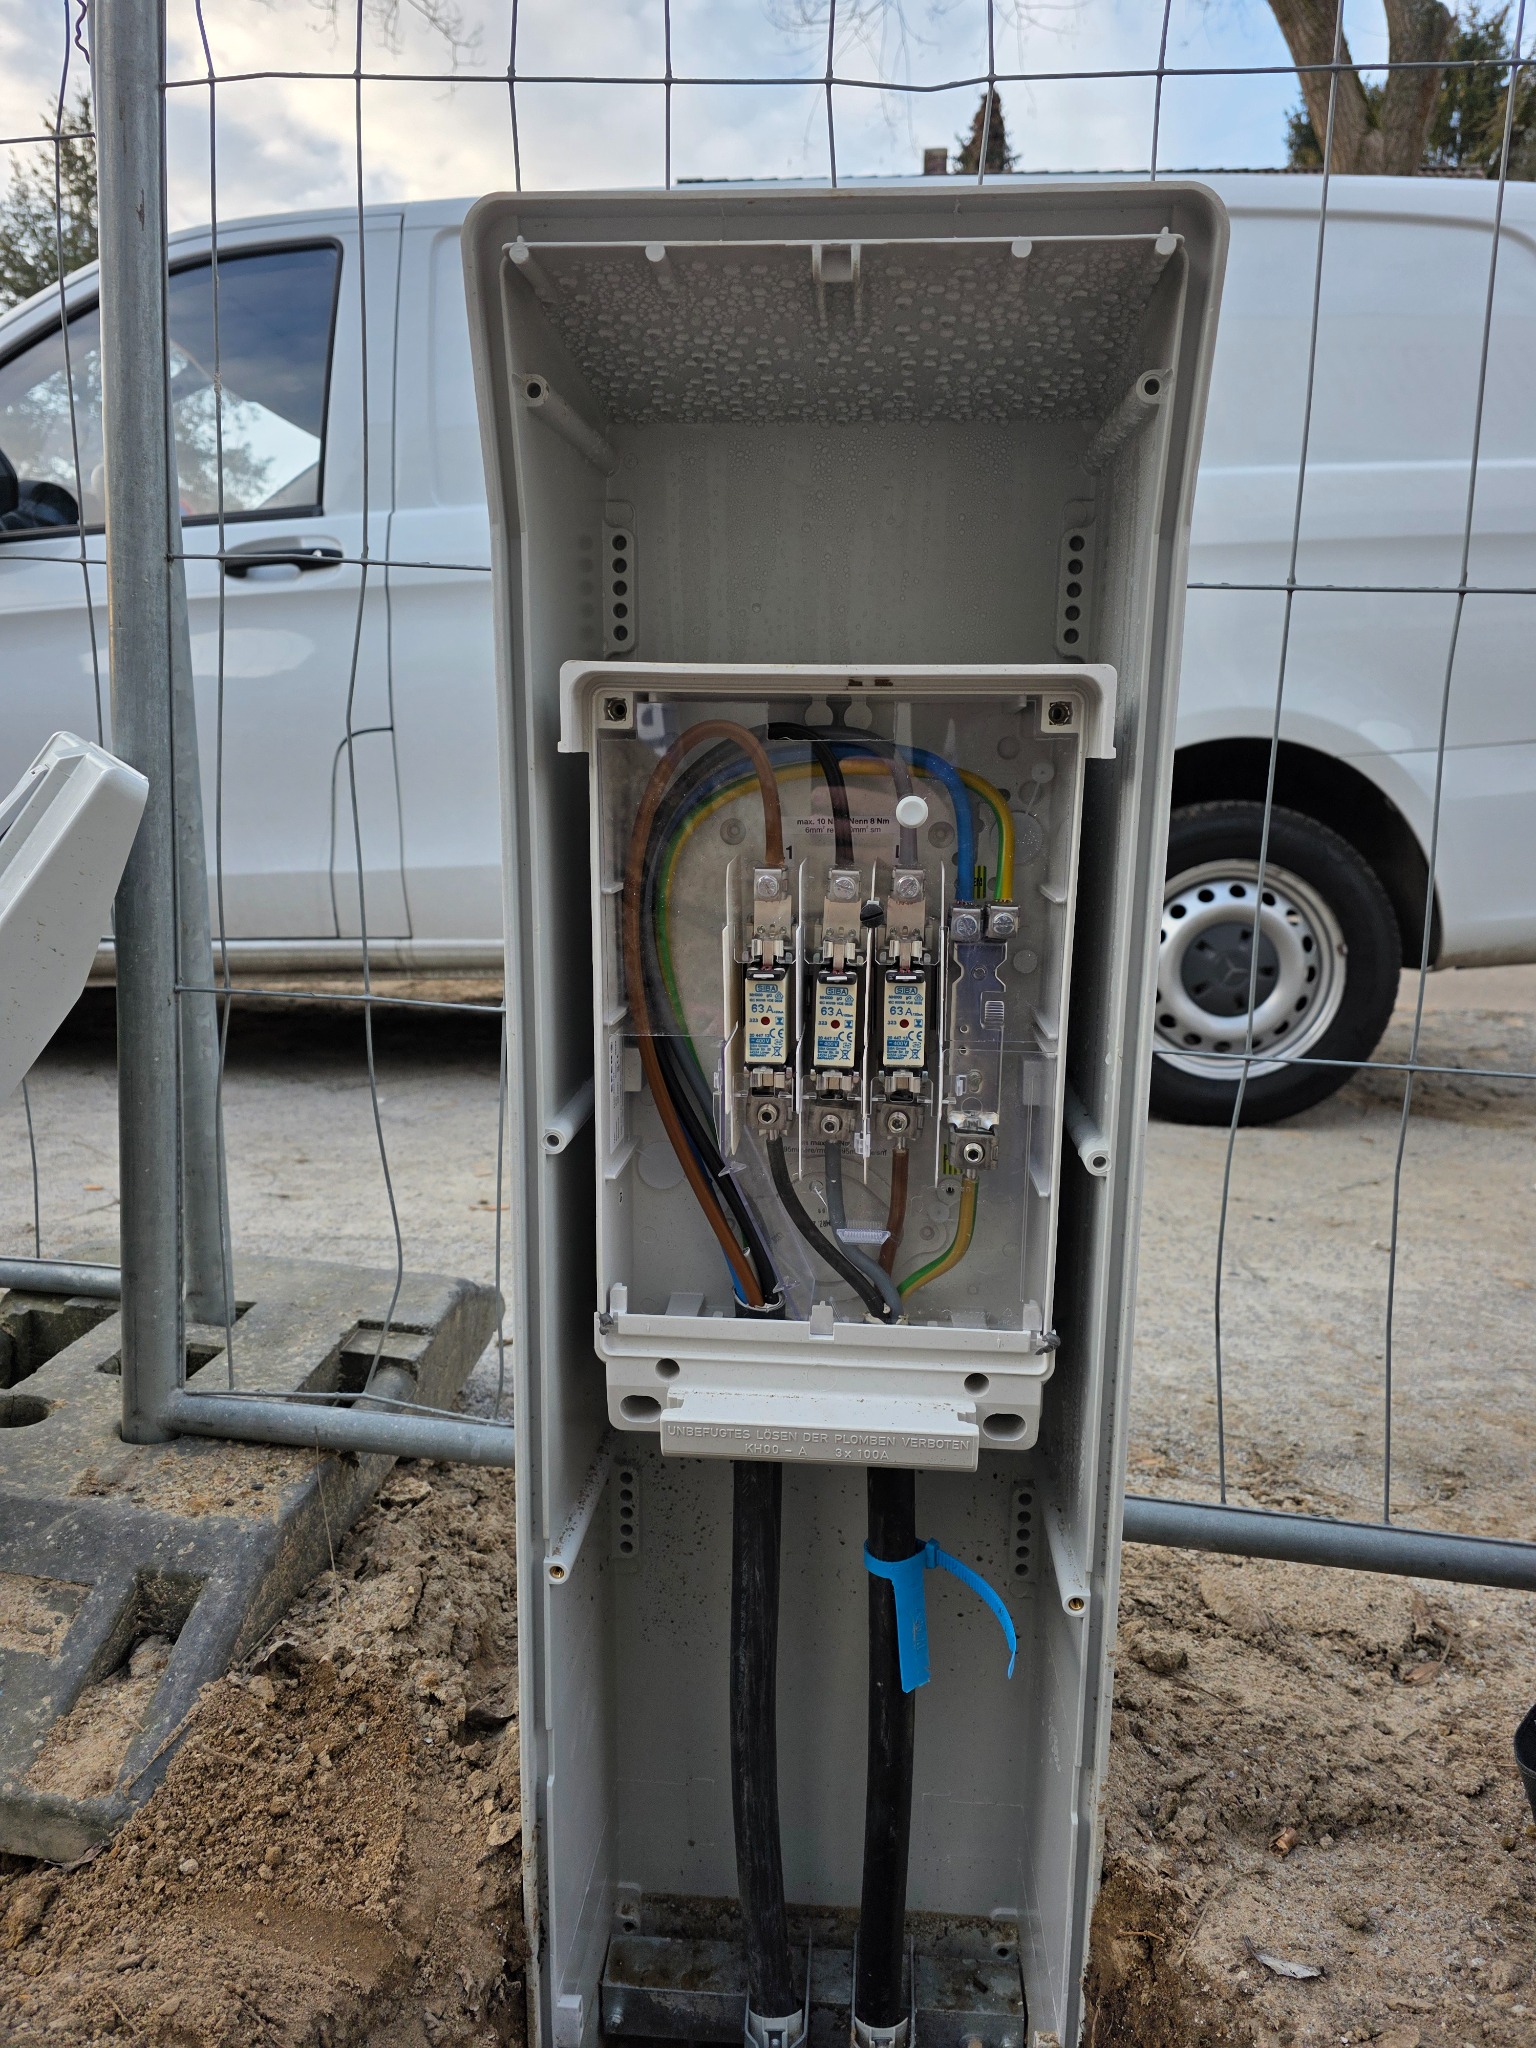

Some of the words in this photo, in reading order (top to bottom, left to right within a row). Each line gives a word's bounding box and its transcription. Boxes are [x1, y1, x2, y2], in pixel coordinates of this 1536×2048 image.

[797, 818, 815, 826] max.
[869, 817, 875, 825] 8
[876, 817, 890, 825] Nm
[895, 986, 917, 994] SIBA
[751, 1003, 765, 1013] 63
[820, 1006, 834, 1016] 63
[889, 1006, 904, 1016] 63
[667, 1425, 751, 1439] UNBEFUGTES
[756, 1429, 798, 1442] LÖSEN
[803, 1432, 828, 1443] DER
[834, 1434, 896, 1446] PLOMBEN
[902, 1437, 970, 1450] VERBOTEN
[798, 1446, 808, 1456] A
[858, 1450, 890, 1460] 100A
